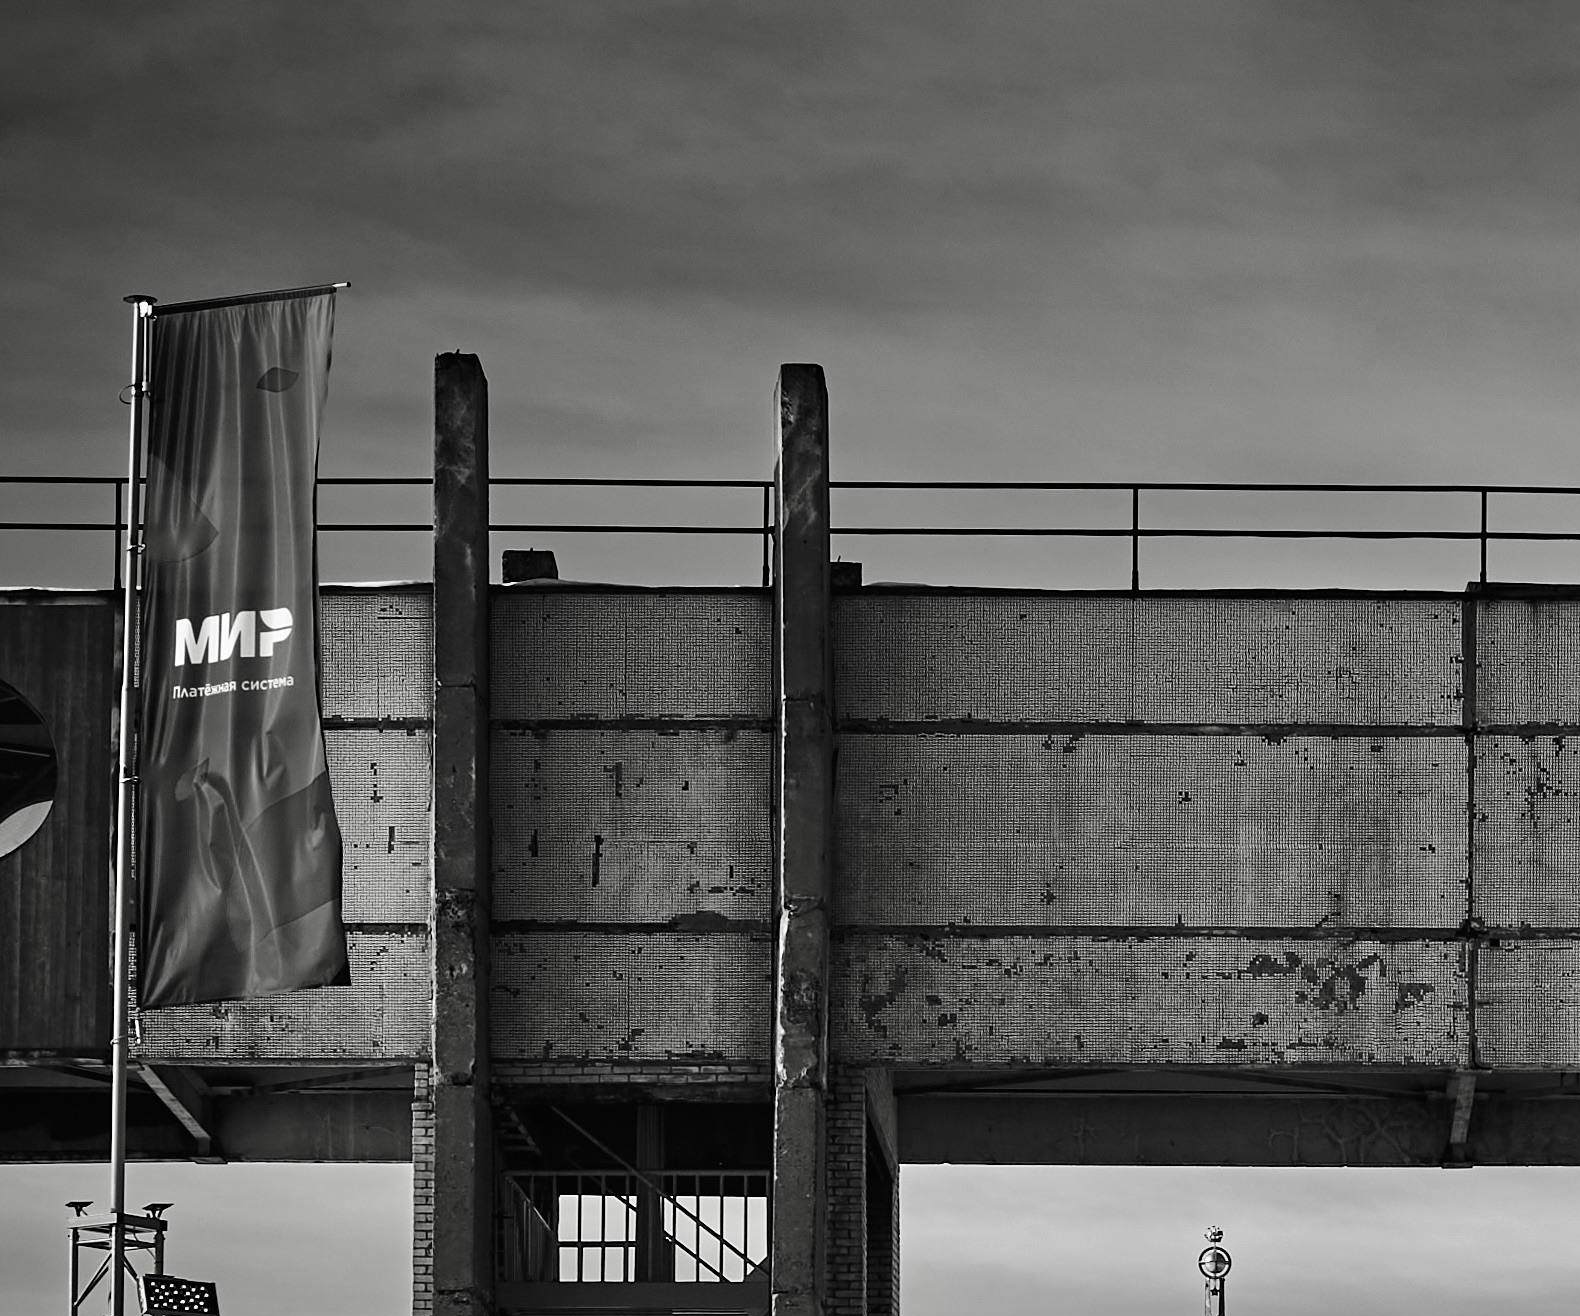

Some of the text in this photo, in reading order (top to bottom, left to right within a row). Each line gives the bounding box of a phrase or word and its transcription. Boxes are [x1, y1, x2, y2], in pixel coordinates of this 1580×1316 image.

[174, 607, 293, 667] МИР
[173, 676, 294, 699] Платёжная система
